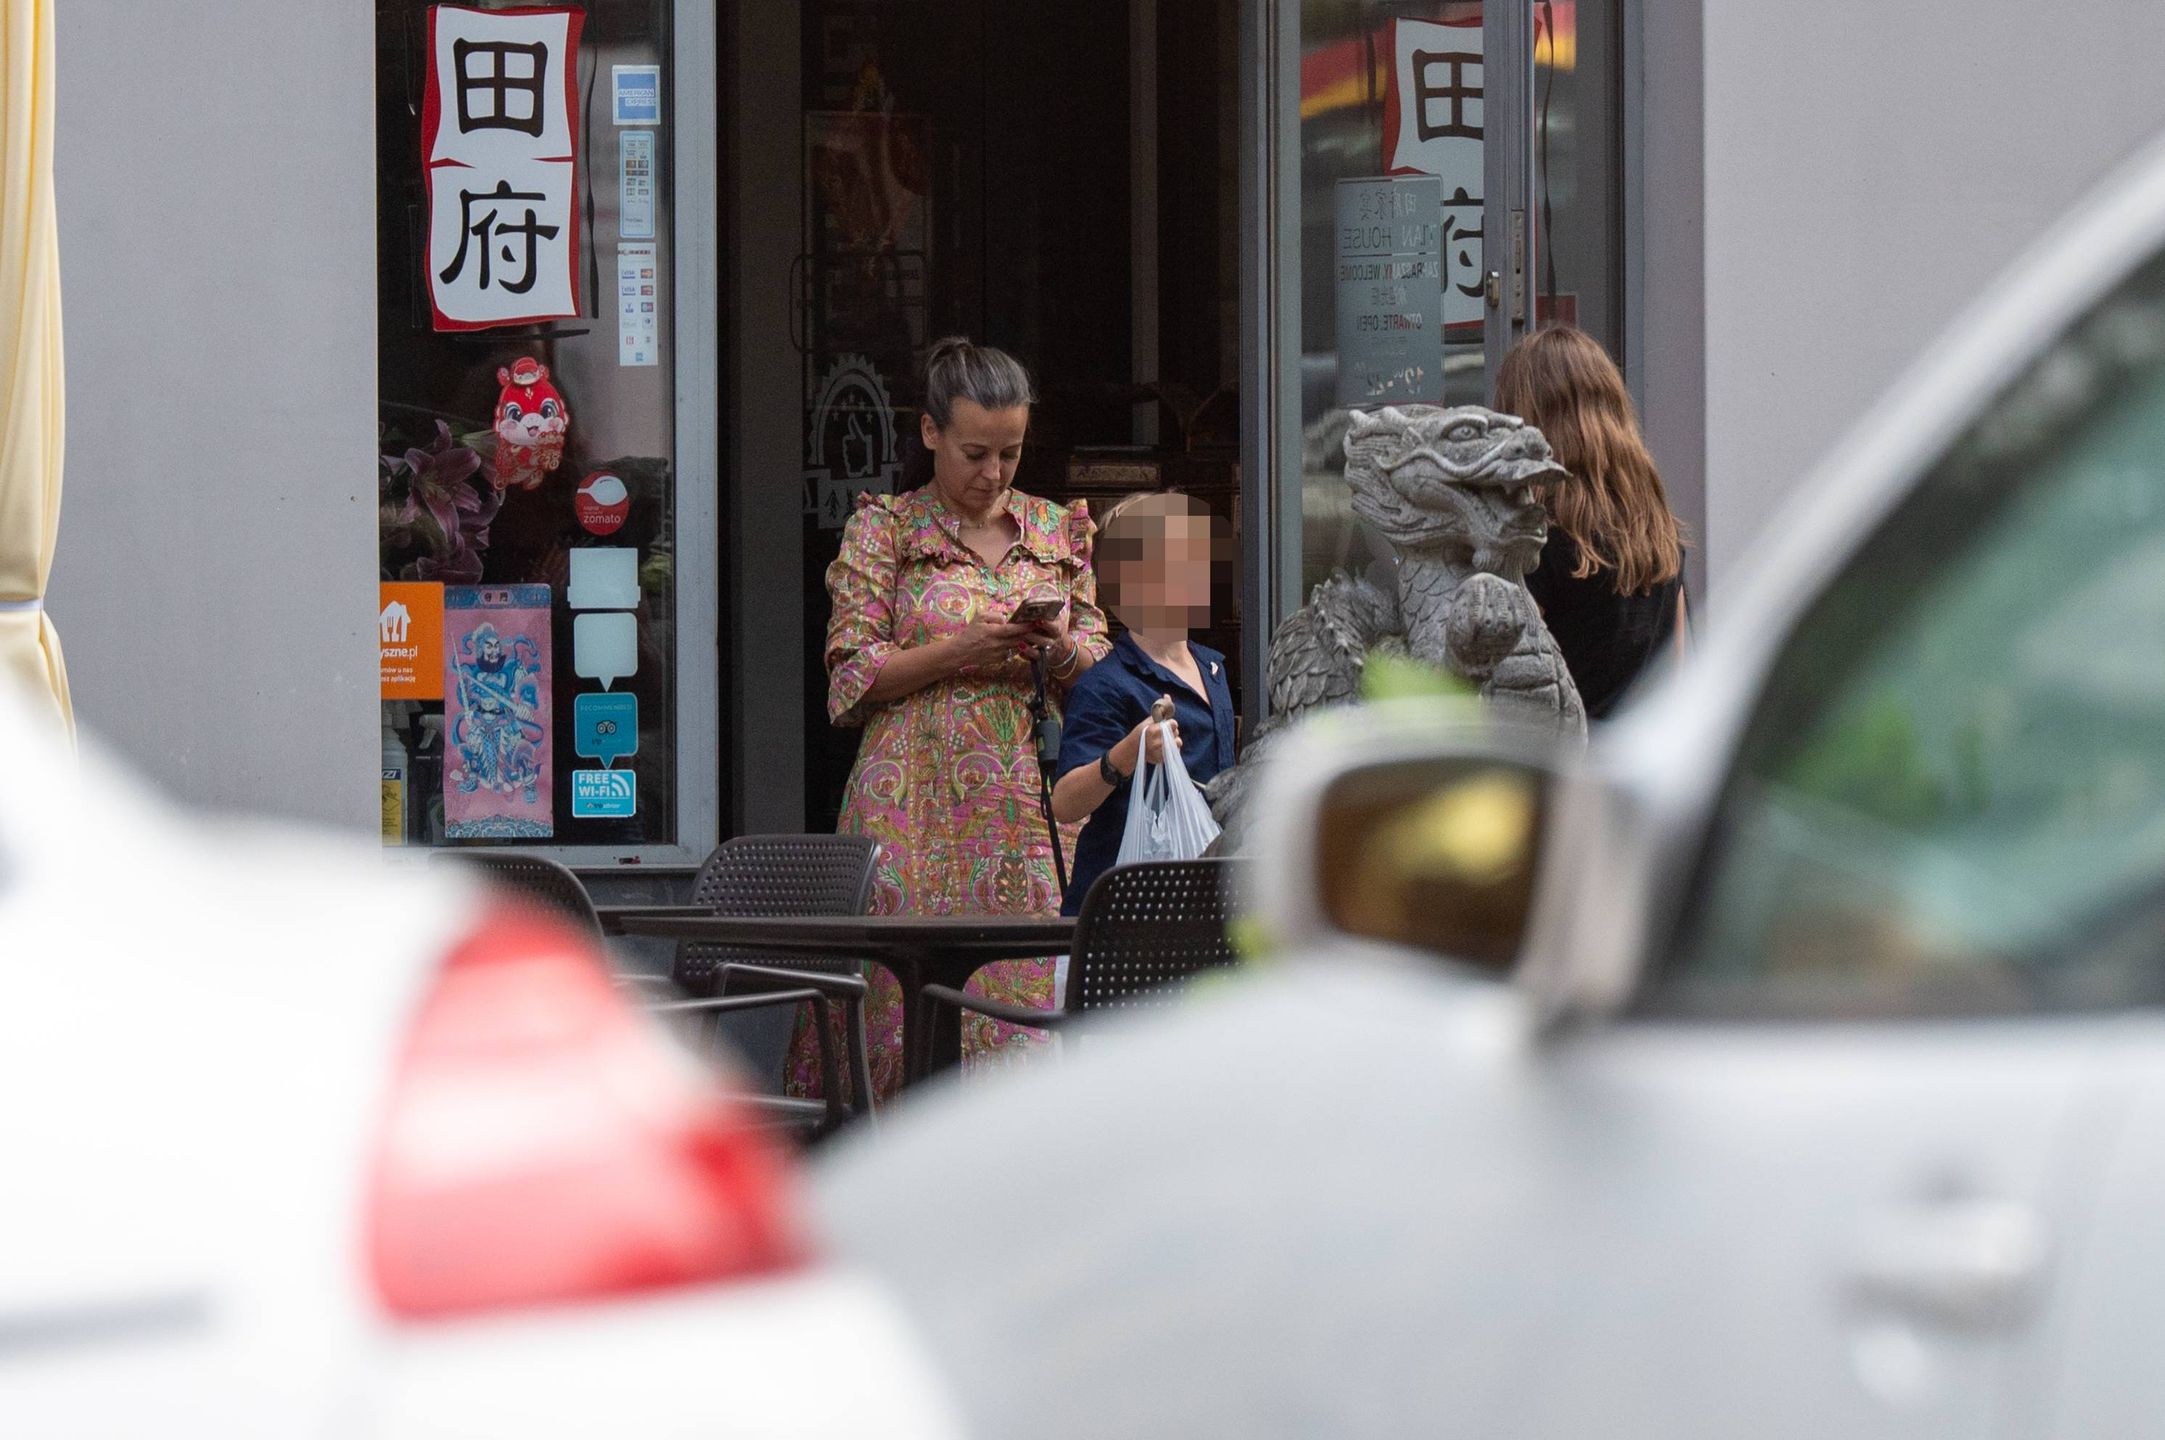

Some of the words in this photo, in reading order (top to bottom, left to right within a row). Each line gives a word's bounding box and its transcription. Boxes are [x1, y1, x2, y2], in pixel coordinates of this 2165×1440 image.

[439, 37, 560, 294] 田府
[583, 513, 621, 524] zomato
[579, 773, 609, 784] FREE
[578, 785, 610, 797] WI-FI
